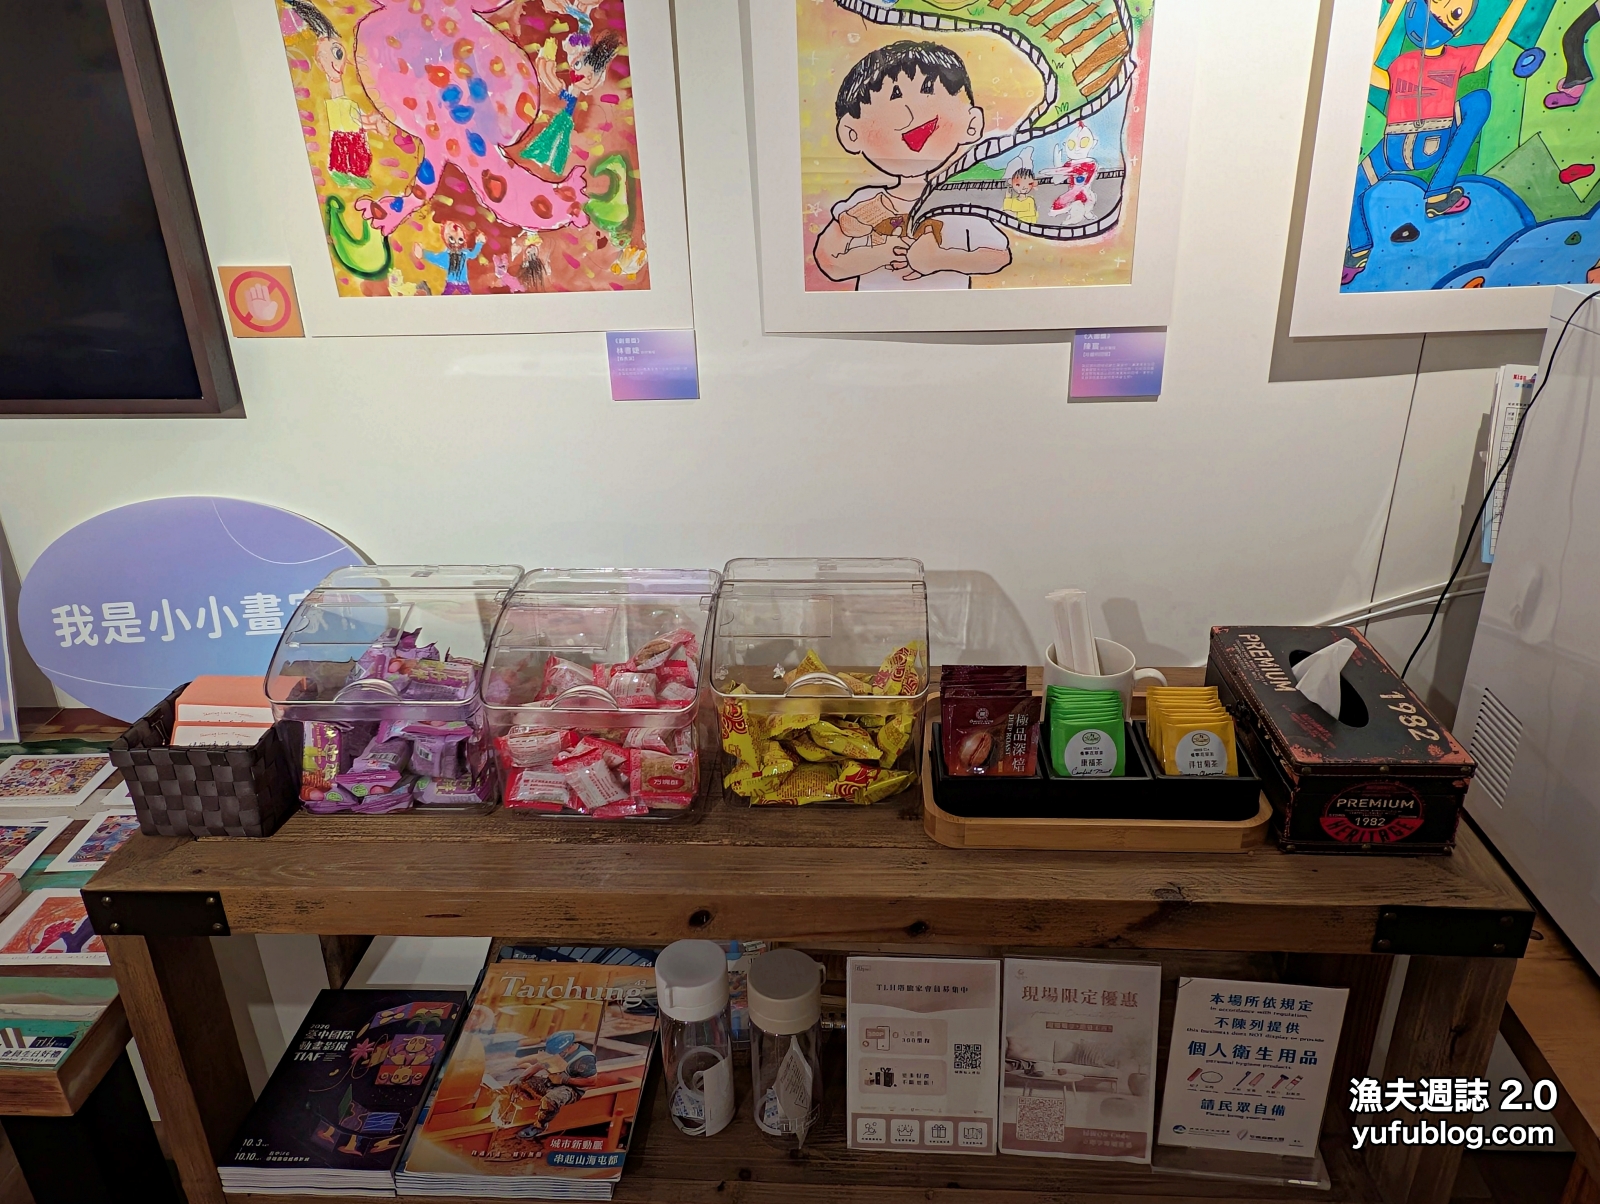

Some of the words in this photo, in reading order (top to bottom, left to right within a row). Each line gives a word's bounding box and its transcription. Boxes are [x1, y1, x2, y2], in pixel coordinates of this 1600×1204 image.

[1238, 633, 1297, 692] PREMIUM
[1379, 690, 1440, 741] 1982
[1005, 732, 1013, 757] ROAST
[1336, 798, 1415, 809] PREMIUM
[1325, 820, 1415, 843] HERITAGE
[1354, 816, 1387, 827] 1982
[500, 976, 644, 1009] Taichung
[1021, 985, 1139, 1008] 現場限定優惠
[1210, 993, 1314, 1012] 本場所依規定
[1214, 1016, 1300, 1035] 不陳列提供
[293, 1051, 325, 1062] TIAF
[1187, 1040, 1318, 1066] 個人衛生用品
[1200, 1098, 1286, 1117] 請民眾自備
